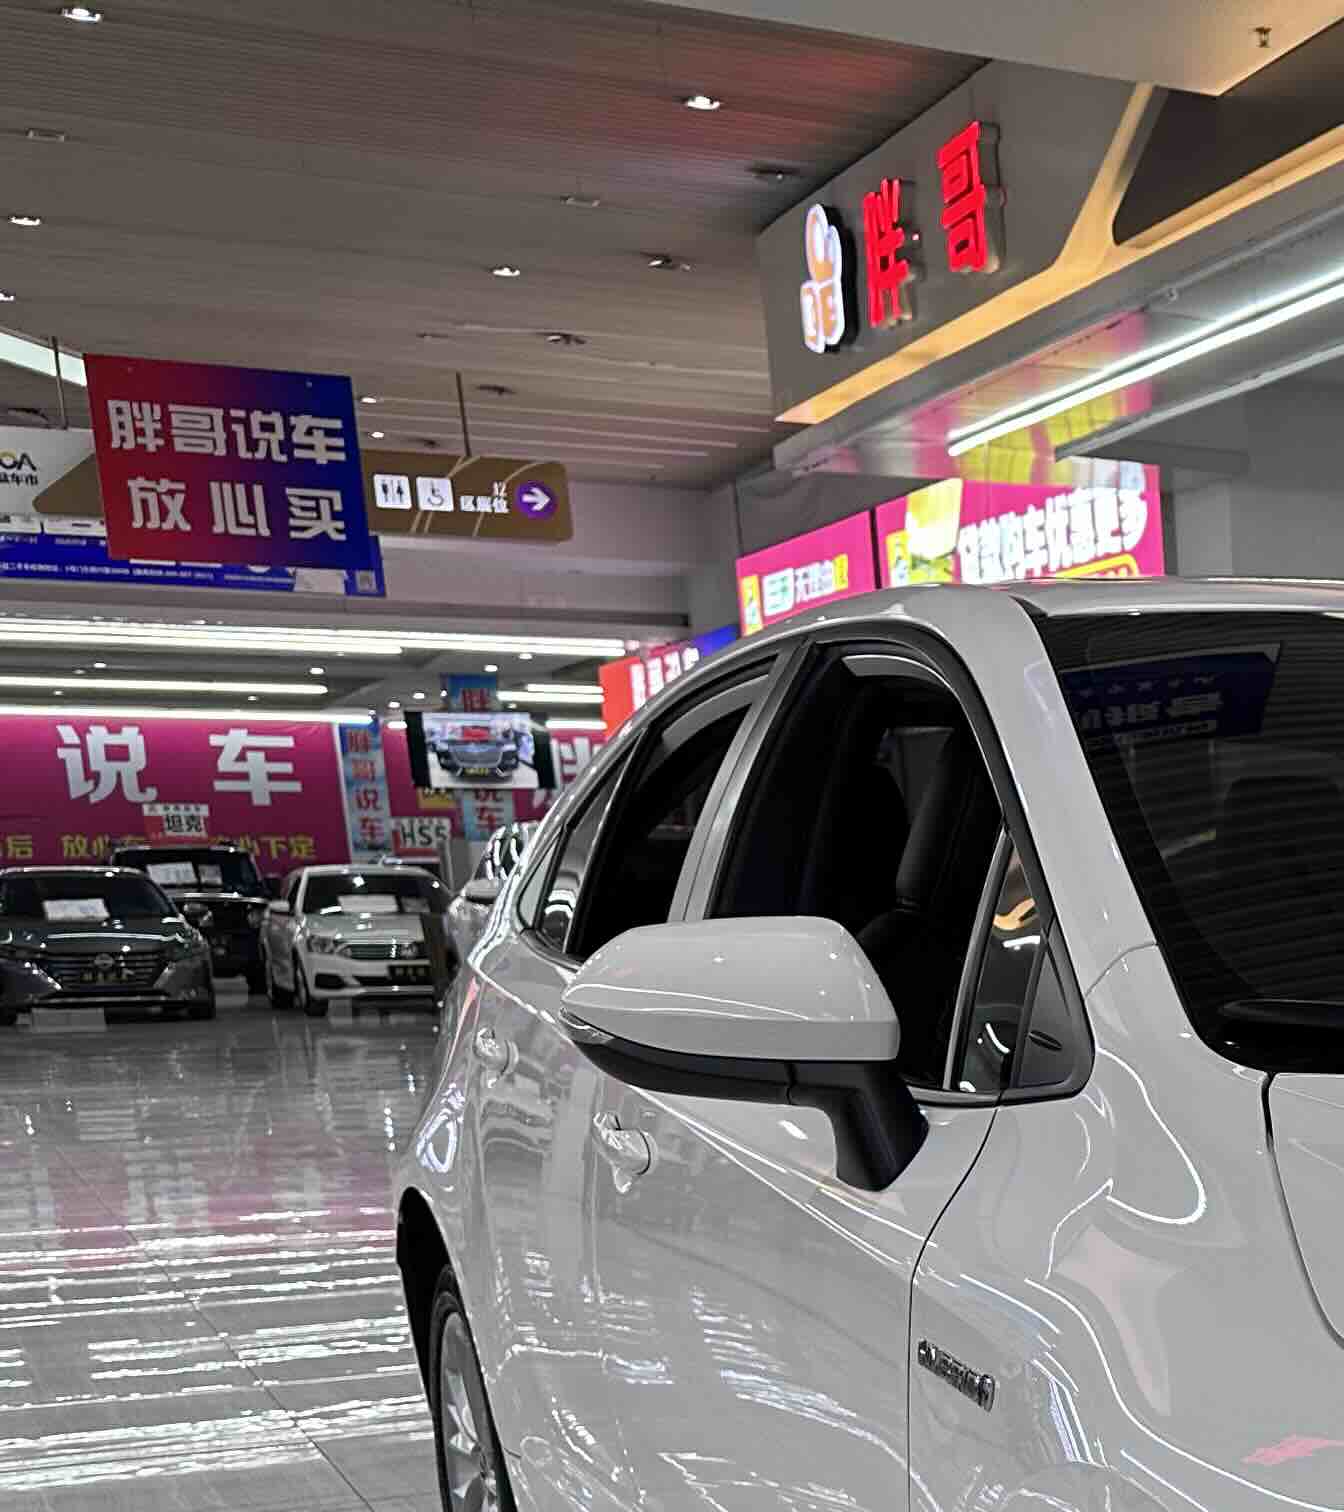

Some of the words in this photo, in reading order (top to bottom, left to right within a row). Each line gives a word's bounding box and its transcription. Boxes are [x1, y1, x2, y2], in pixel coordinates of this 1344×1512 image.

[107, 399, 348, 465] 胖哥说车
[128, 476, 348, 542] 放心买
